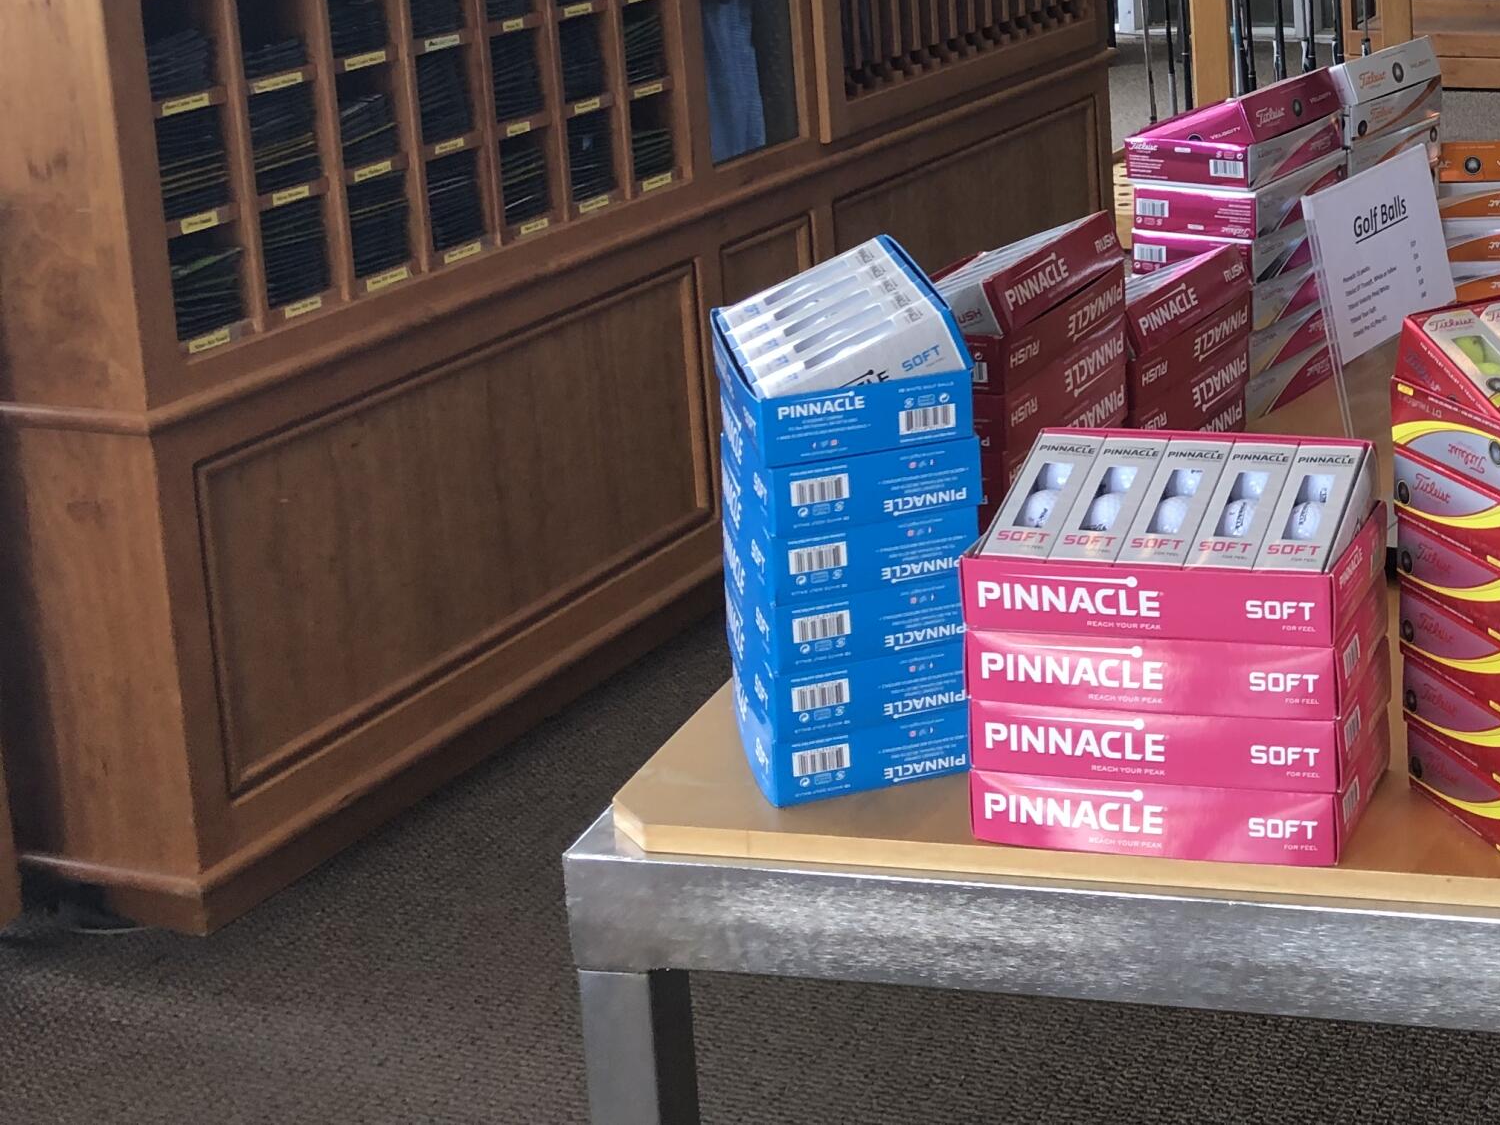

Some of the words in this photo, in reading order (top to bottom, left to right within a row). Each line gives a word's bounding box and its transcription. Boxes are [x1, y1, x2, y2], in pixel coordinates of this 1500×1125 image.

[1256, 107, 1285, 127] Titleist
[1210, 126, 1241, 140] VELOCITY
[1129, 141, 1158, 151] Titleist
[1353, 205, 1378, 238] Golf
[1381, 195, 1407, 226] Balls
[1005, 258, 1069, 311] PINNACLE
[1094, 233, 1117, 253] RUSH
[1223, 262, 1245, 283] RUSH
[957, 308, 982, 324] USH
[1068, 279, 1123, 336] PINNACLE
[1138, 287, 1199, 336] PINNACLE
[1193, 304, 1248, 358] PINNACLE
[1429, 318, 1476, 332] Titleist
[901, 344, 941, 372] SOFT
[1010, 339, 1040, 369] RUSH
[1064, 331, 1124, 393] PINNACLE
[1141, 360, 1168, 387] RUSH
[1192, 352, 1248, 408] PINNACLE
[777, 395, 865, 420] PINNACLE
[1010, 396, 1038, 427] RUSH
[1039, 444, 1096, 455] PINNACLE
[1103, 448, 1159, 458] PINNACLE
[1168, 450, 1224, 460] PINNACLE
[1232, 453, 1289, 463] PINNACLE
[1298, 455, 1355, 465] PINNACLE
[1448, 444, 1487, 474] Titleist
[1413, 473, 1451, 504] Titleist
[884, 487, 967, 513] PINNACLE
[997, 530, 1050, 544] SOFT
[1064, 535, 1117, 547] SOFT
[1131, 538, 1184, 550] SOFT
[1199, 541, 1253, 554] SOFT
[1267, 544, 1320, 556] SOFT
[977, 581, 1161, 617] PINNACLE
[1245, 600, 1315, 621] SOFT
[981, 652, 1163, 690] PINNACLE
[1249, 672, 1319, 694] SOFT
[883, 689, 966, 716] PINNACLE
[1088, 693, 1116, 701] REACH
[1117, 695, 1139, 703] YOUR
[984, 722, 1165, 762] PINNACLE
[884, 753, 966, 780] PINNACLE
[1250, 744, 1320, 767] SOFT
[1091, 765, 1119, 773] REACH
[1143, 768, 1165, 776] PEAK
[984, 792, 1163, 835] PINNACLE
[1248, 818, 1318, 840] SOFT
[1117, 839, 1139, 847] YOUR
[1300, 844, 1318, 852] FEEL
